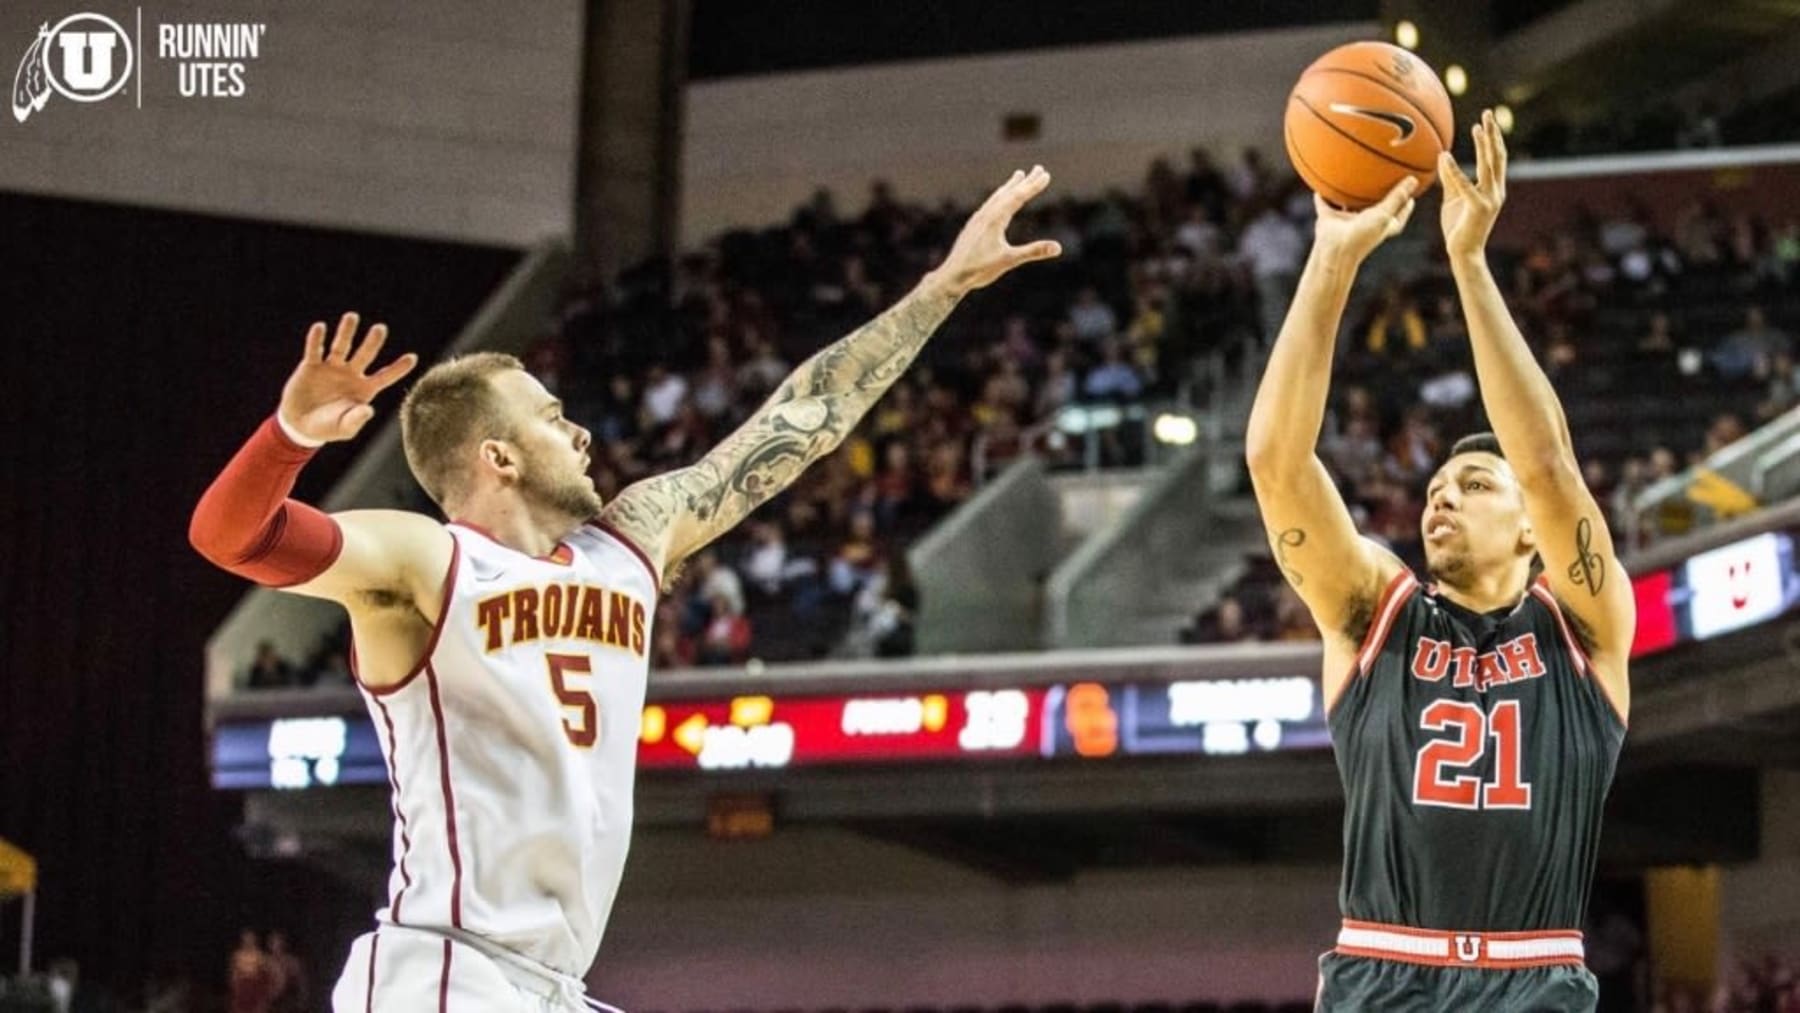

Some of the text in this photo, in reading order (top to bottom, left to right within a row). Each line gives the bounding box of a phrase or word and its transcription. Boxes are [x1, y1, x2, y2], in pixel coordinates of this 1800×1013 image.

[476, 582, 647, 658] TROJANS
[545, 651, 599, 749] 5
[1411, 632, 1547, 692] UTAH
[1412, 699, 1531, 810] 21
[1454, 936, 1481, 961] U
